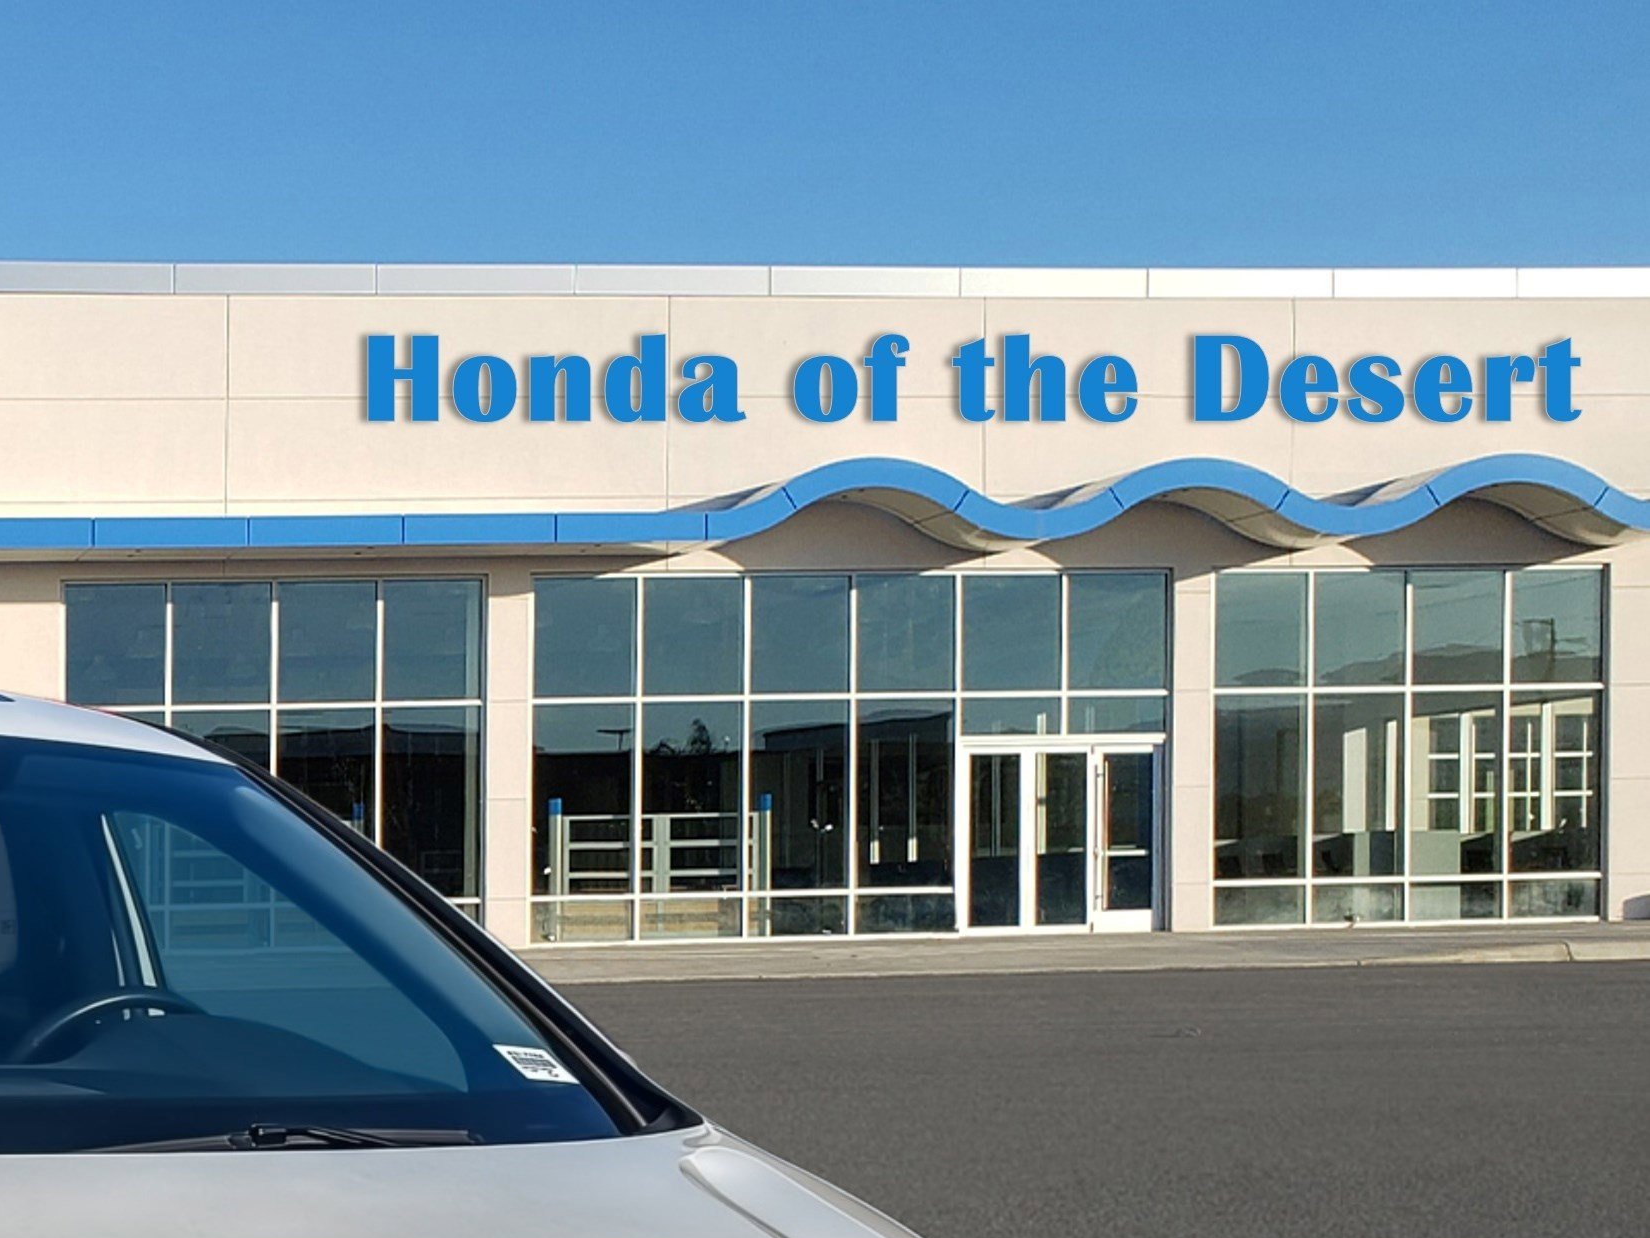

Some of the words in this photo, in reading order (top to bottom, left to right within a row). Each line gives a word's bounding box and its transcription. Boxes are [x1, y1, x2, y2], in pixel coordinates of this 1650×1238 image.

[366, 334, 746, 423] Honda
[794, 333, 911, 423] of
[951, 334, 1138, 423] the
[1193, 335, 1582, 423] Desert
